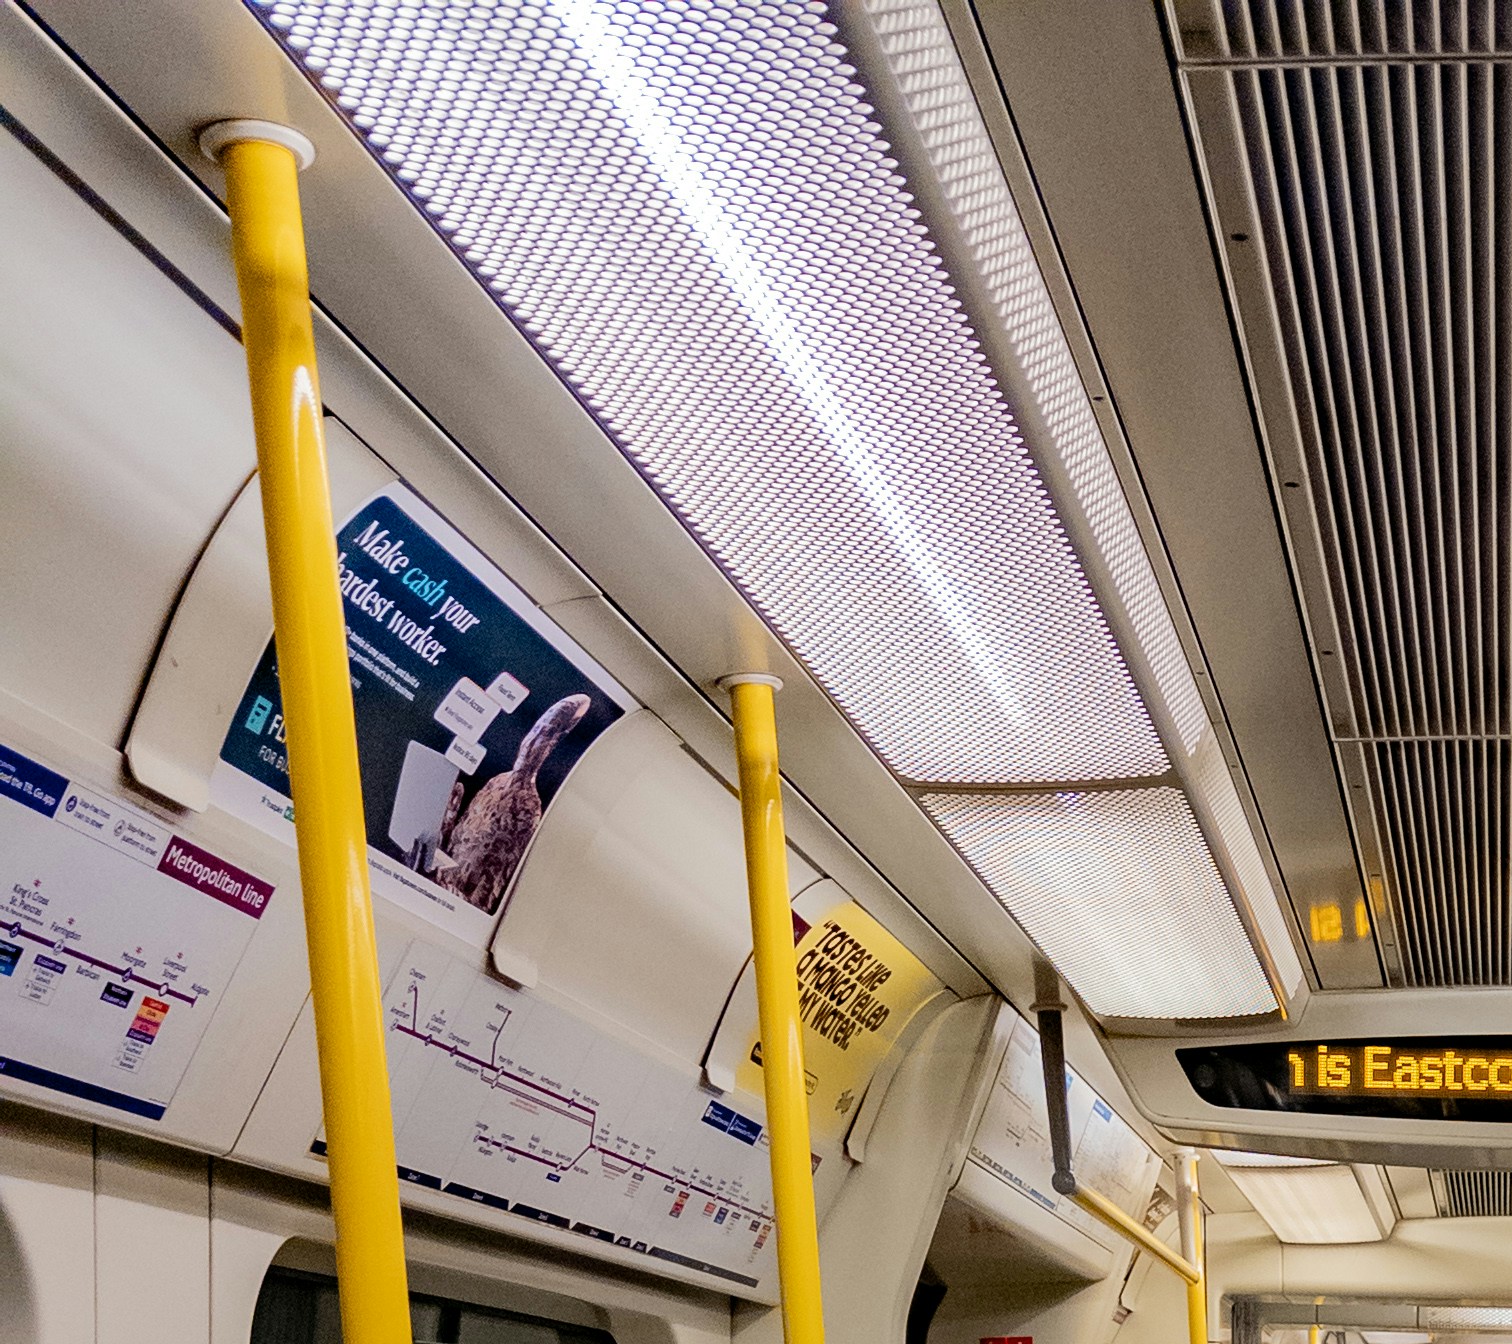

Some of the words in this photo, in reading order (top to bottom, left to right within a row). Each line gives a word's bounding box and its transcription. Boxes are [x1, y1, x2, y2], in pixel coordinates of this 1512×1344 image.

[353, 520, 410, 574] Make
[402, 567, 448, 606] cash
[429, 595, 481, 633] your
[387, 609, 447, 666] worker.
[258, 745, 276, 768] FOR
[166, 845, 242, 897] Metropolitan
[241, 883, 264, 908] line
[1317, 1045, 1351, 1088] is
